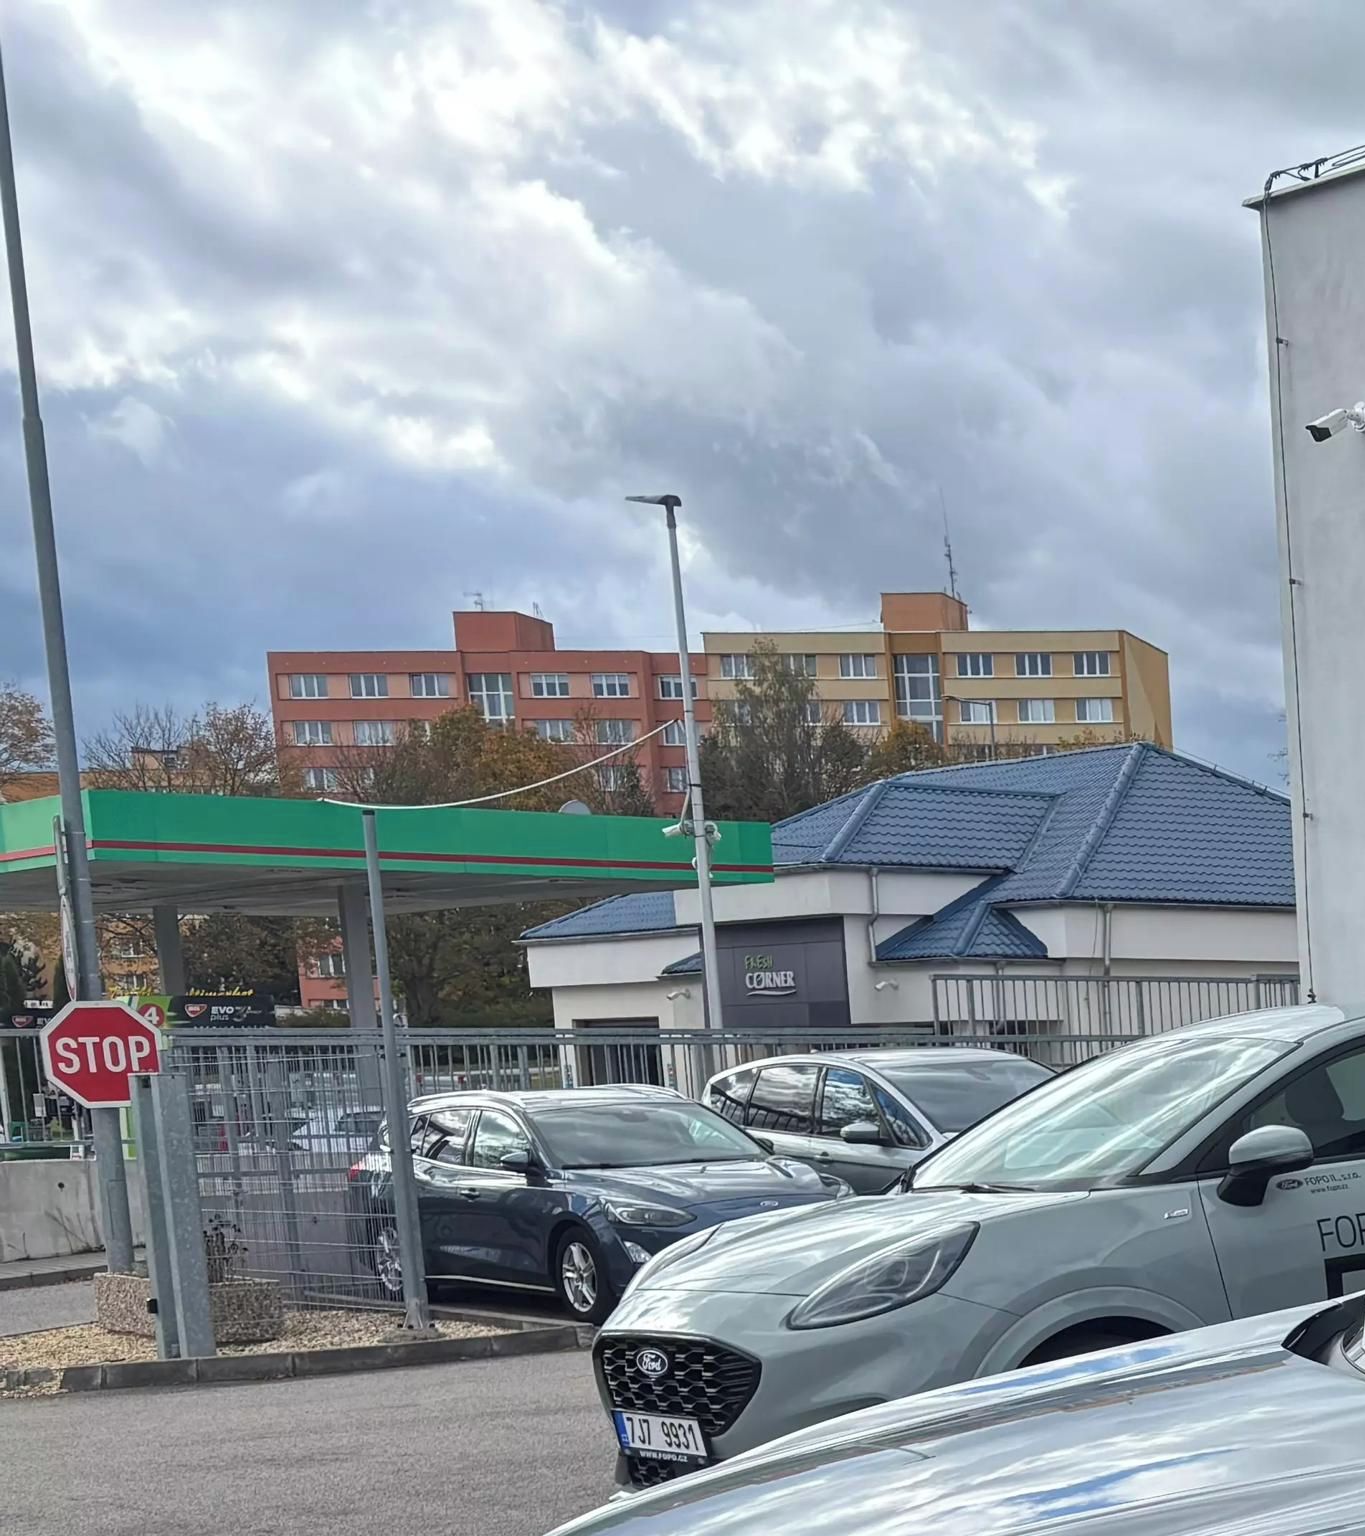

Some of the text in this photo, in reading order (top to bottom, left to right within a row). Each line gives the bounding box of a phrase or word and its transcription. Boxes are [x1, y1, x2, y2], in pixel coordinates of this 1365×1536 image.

[744, 955, 773, 970] FRESH
[143, 1007, 159, 1024] 4
[210, 1014, 230, 1022] plus
[211, 1006, 234, 1015] EVO
[55, 1035, 150, 1074] STOP
[1304, 1176, 1330, 1187] FOPO
[641, 1353, 662, 1371] Ford
[626, 1416, 699, 1452] 7J7 9931
